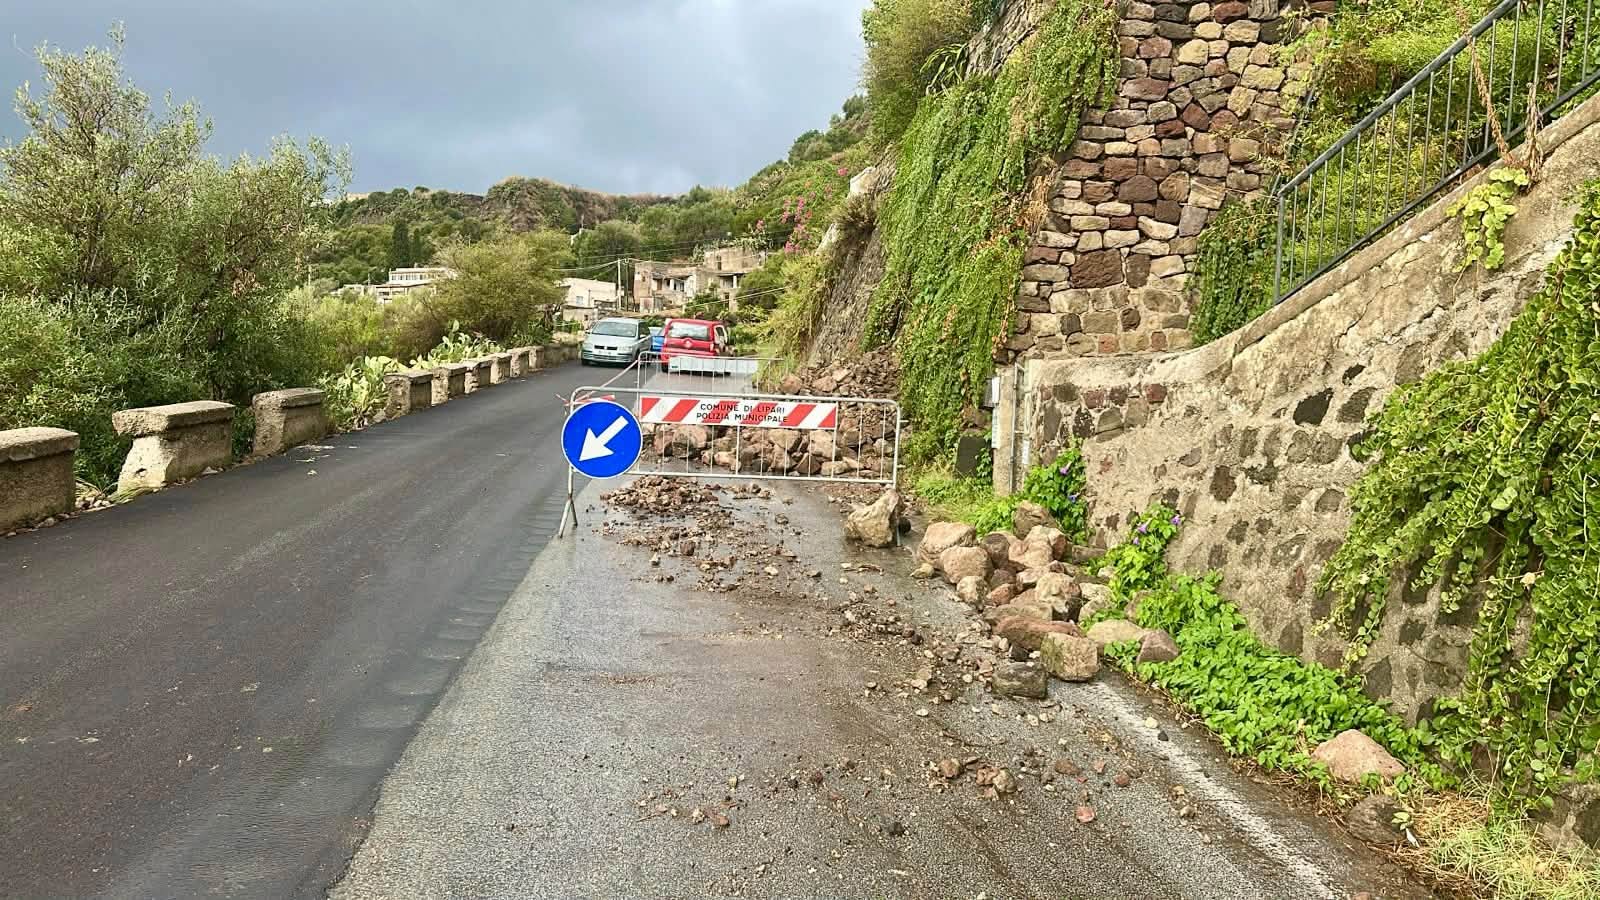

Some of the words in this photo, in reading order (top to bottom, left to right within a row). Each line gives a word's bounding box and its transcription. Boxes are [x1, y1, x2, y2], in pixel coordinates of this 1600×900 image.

[700, 403, 739, 412] COMUNE
[744, 404, 753, 412] DI
[757, 405, 785, 414] LIPARI
[696, 412, 730, 421] POLIZIA
[734, 414, 788, 423] MUNICIPALE
